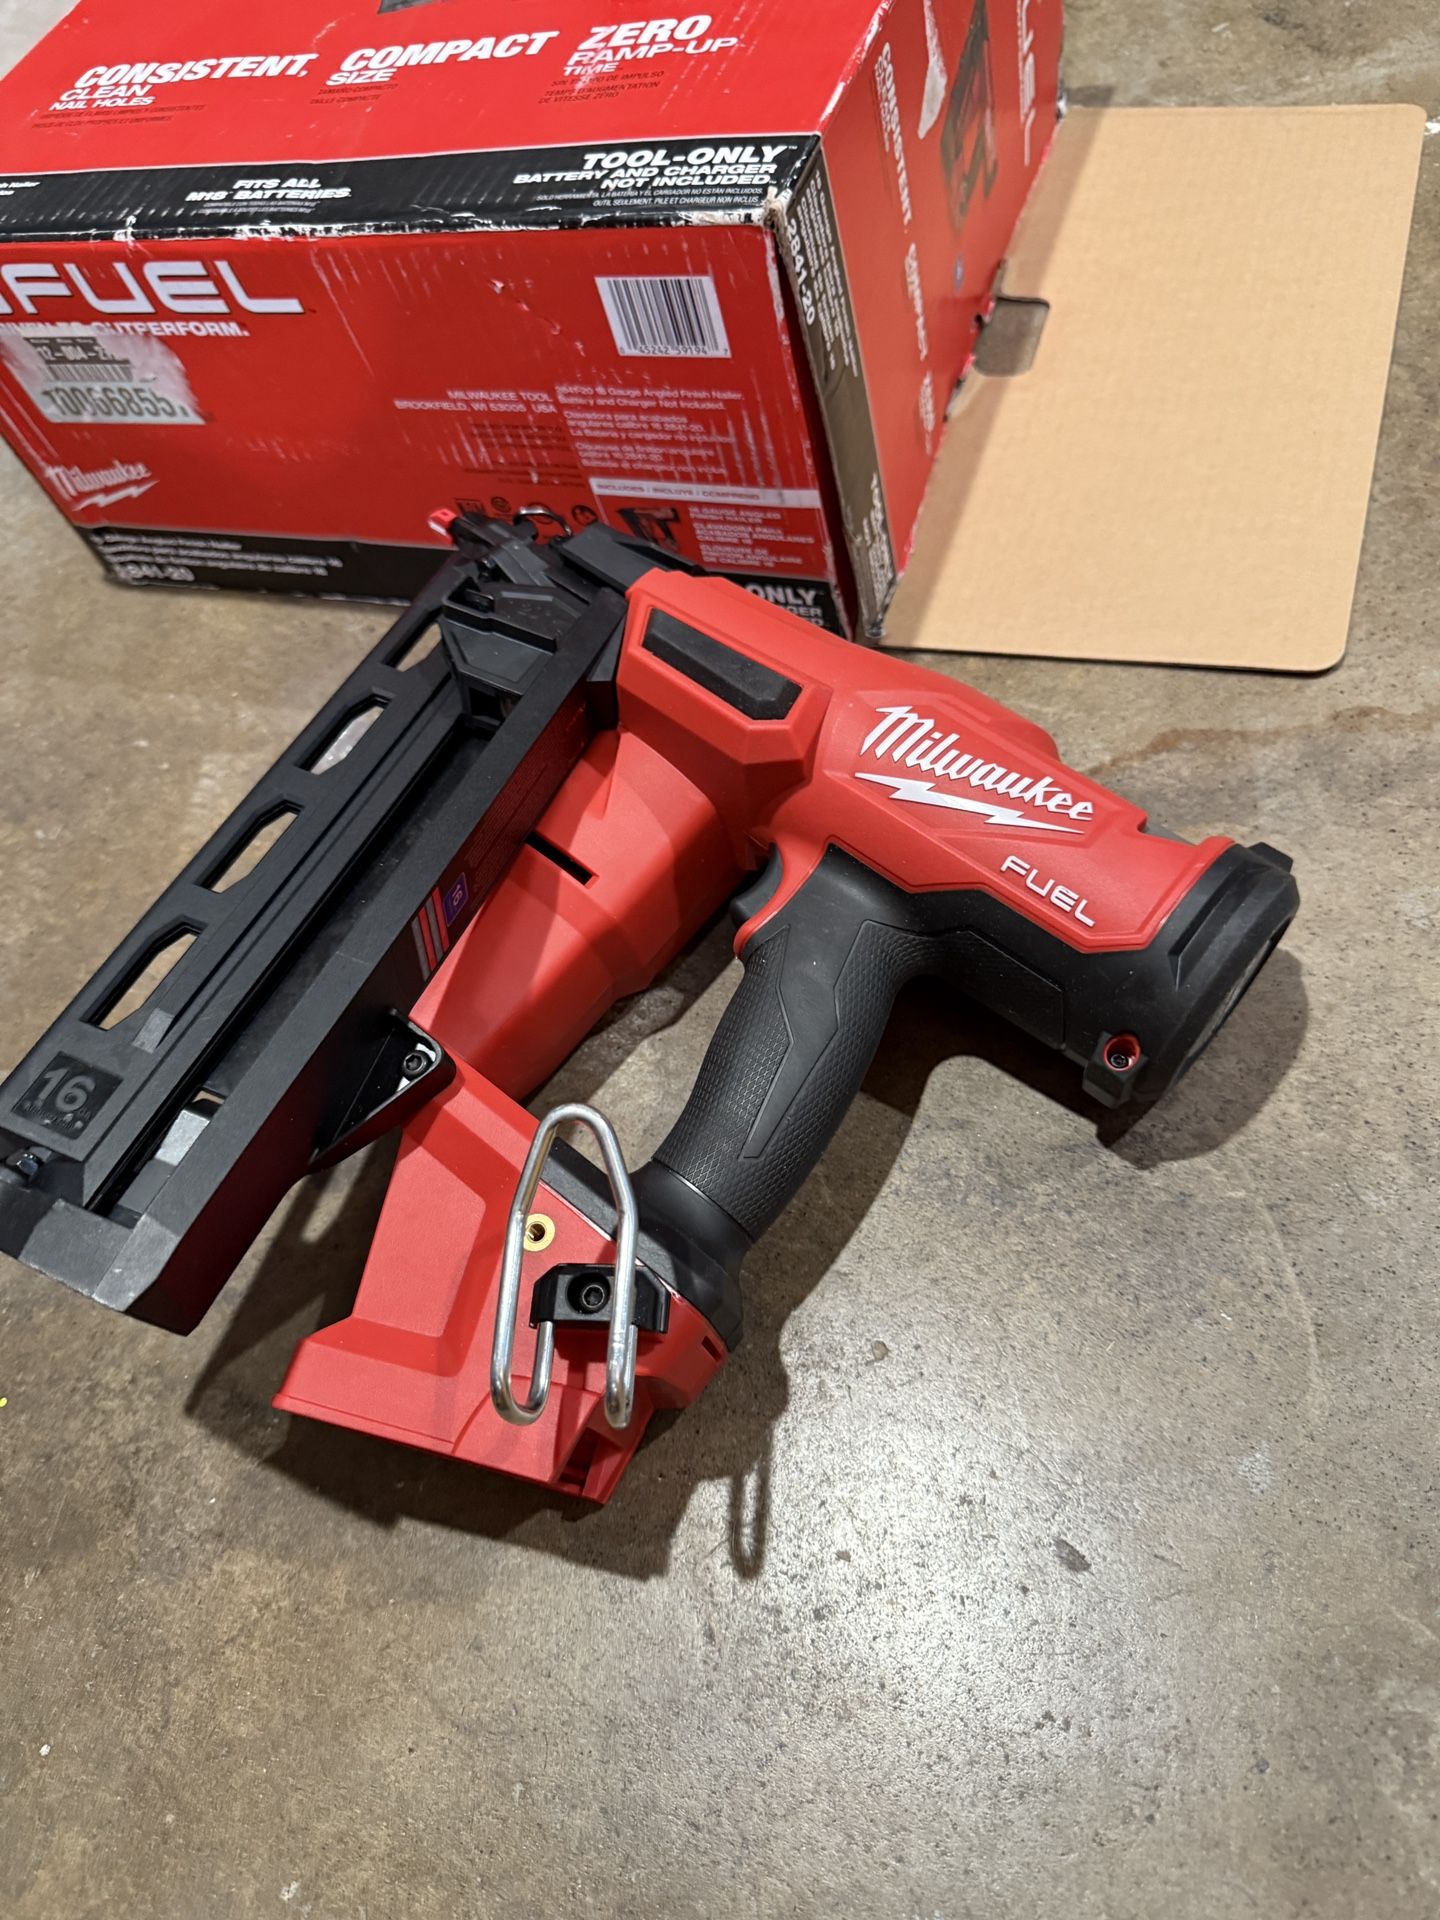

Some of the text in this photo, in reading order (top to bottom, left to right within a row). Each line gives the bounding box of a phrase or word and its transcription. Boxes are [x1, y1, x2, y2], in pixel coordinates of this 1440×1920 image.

[577, 14, 713, 50] ZERO
[340, 31, 560, 72] COMPACT
[566, 37, 739, 66] RAMP-UP
[326, 68, 398, 86] SIZE
[563, 62, 620, 76] TIME
[59, 84, 153, 101] CLEAN
[49, 100, 88, 111] NAIL
[91, 96, 156, 109] HOLES
[513, 163, 777, 184] BATTERY AND CHARGER
[232, 178, 322, 189] FITS ALL
[600, 178, 649, 189] NOT
[786, 218, 816, 325] 2841-20
[1, 260, 305, 314] FUEL
[447, 390, 553, 402] MILWAUKEE TOOL
[607, 387, 642, 398] Gauge
[643, 387, 680, 399] Angled
[531, 403, 558, 413] USA
[616, 397, 658, 410] Charger
[44, 460, 152, 501] Milwaukee
[860, 705, 1094, 821] Milwaukee
[1000, 855, 1095, 928] FUEL
[34, 1067, 97, 1113] 16
